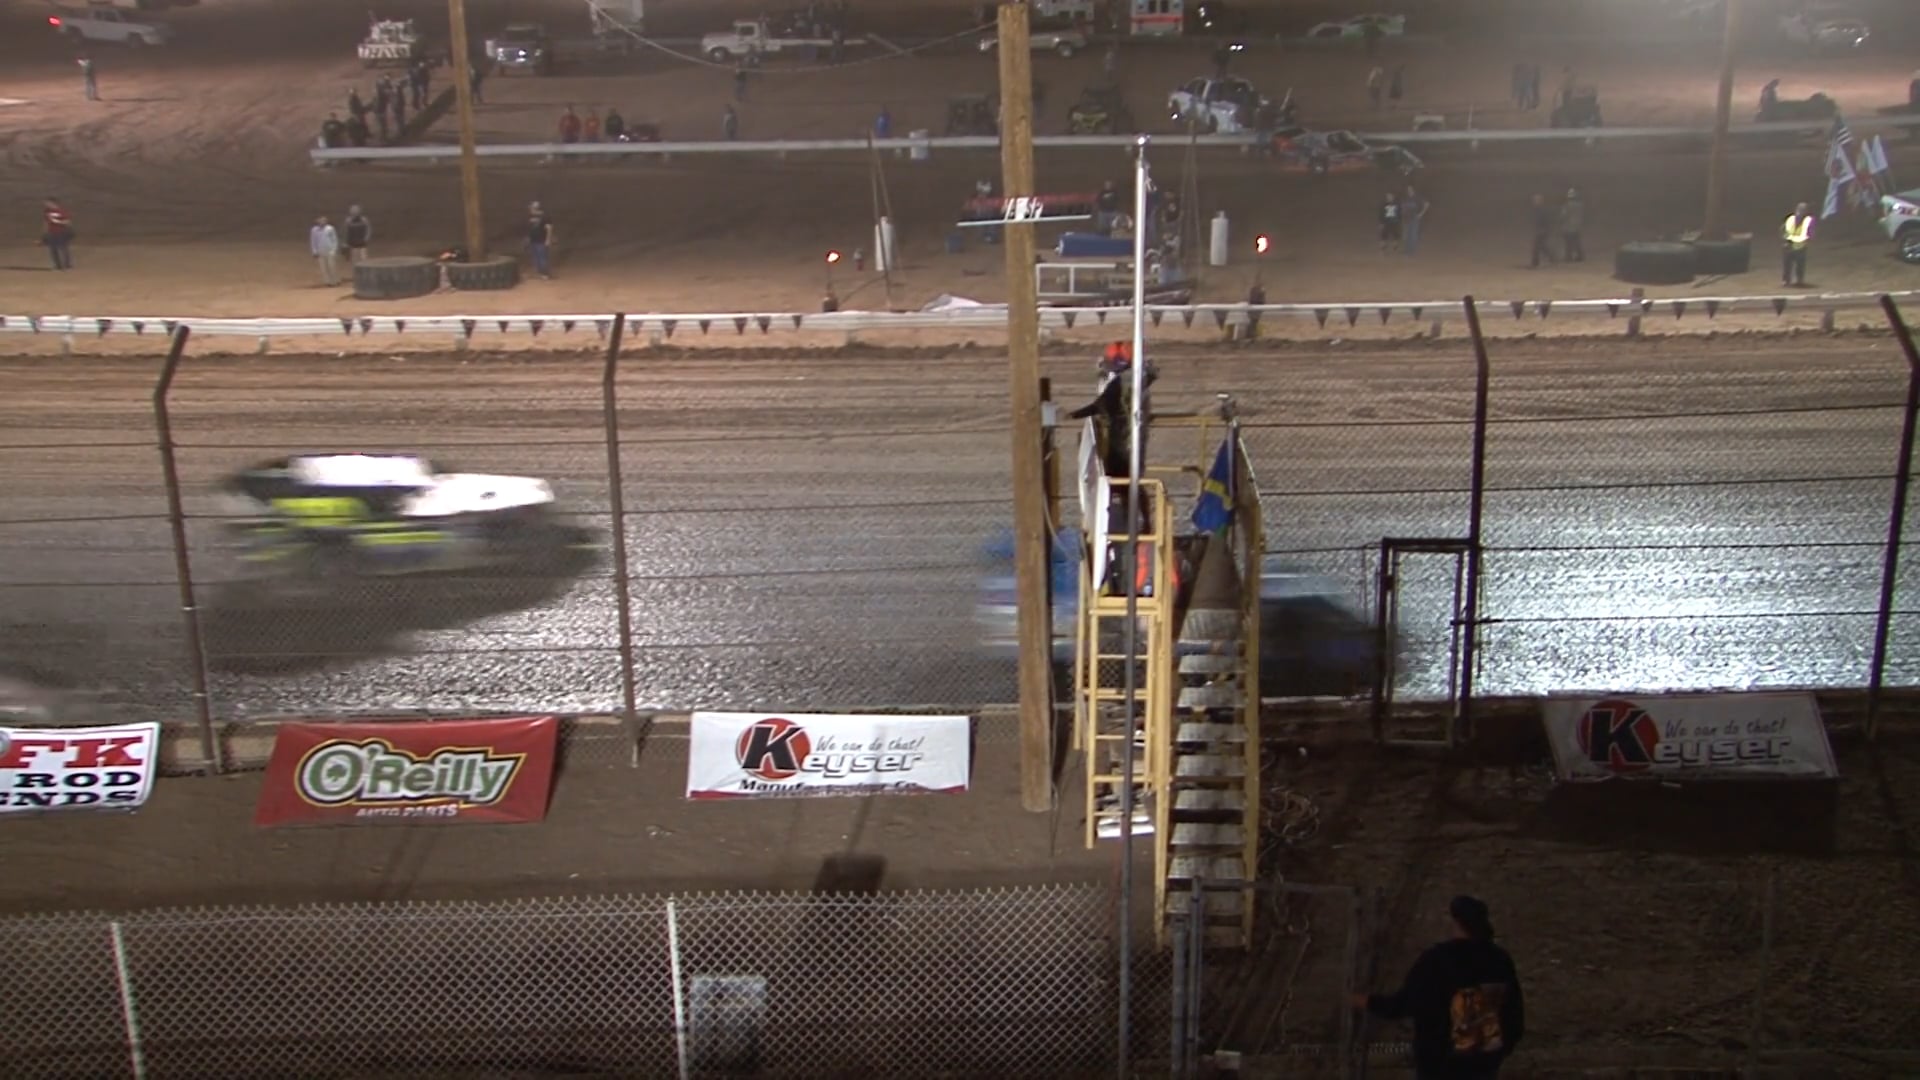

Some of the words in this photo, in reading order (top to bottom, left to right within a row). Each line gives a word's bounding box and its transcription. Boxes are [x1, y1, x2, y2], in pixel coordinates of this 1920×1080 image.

[816, 735, 835, 752] We
[841, 742, 862, 752] can
[867, 738, 883, 751] do
[887, 735, 926, 752] that!
[1589, 708, 1792, 770] Keyser
[741, 725, 922, 778] Keyser
[13, 771, 142, 788] ROD
[303, 745, 515, 801] O'Reilly
[0, 790, 138, 807] NDS
[355, 807, 401, 817] AUTO
[402, 803, 459, 817] PARTS
